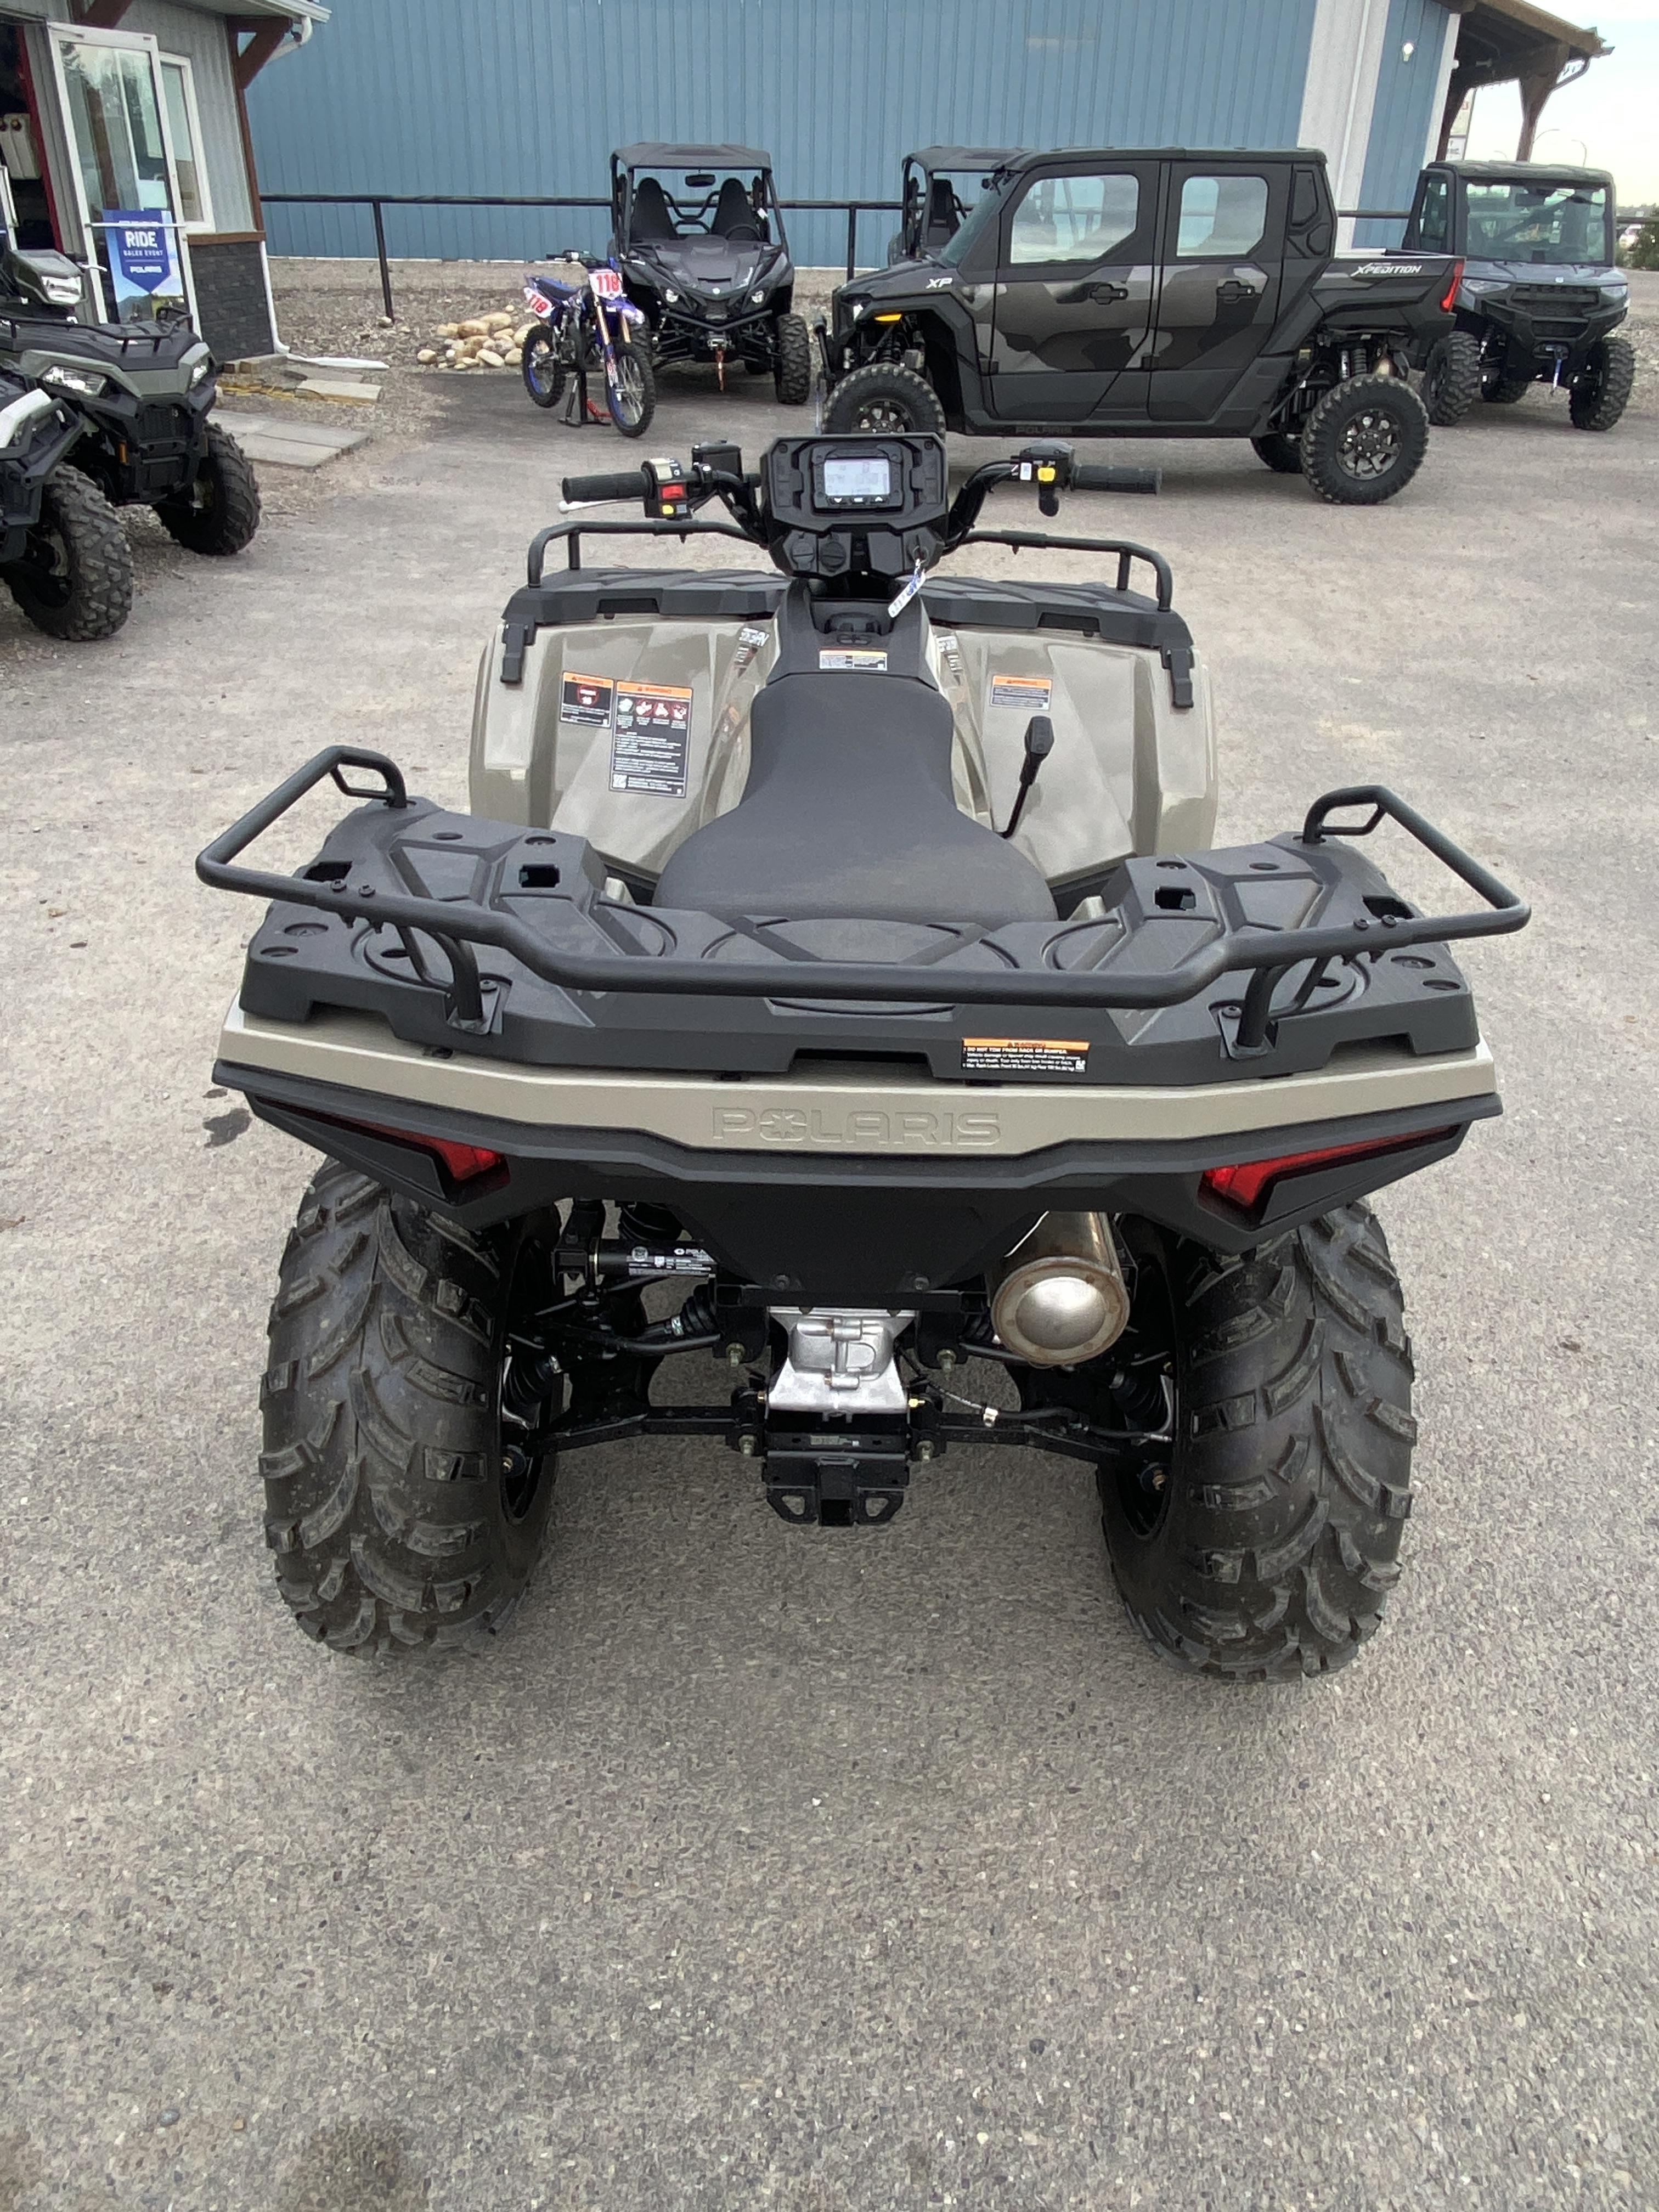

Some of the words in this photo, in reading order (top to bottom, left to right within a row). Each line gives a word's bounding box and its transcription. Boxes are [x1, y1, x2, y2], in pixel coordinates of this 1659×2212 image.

[125, 230, 158, 248] RIDE
[1350, 262, 1423, 277] XPEDITION
[925, 277, 953, 290] XP
[713, 1107, 1001, 1146] POLARIS
